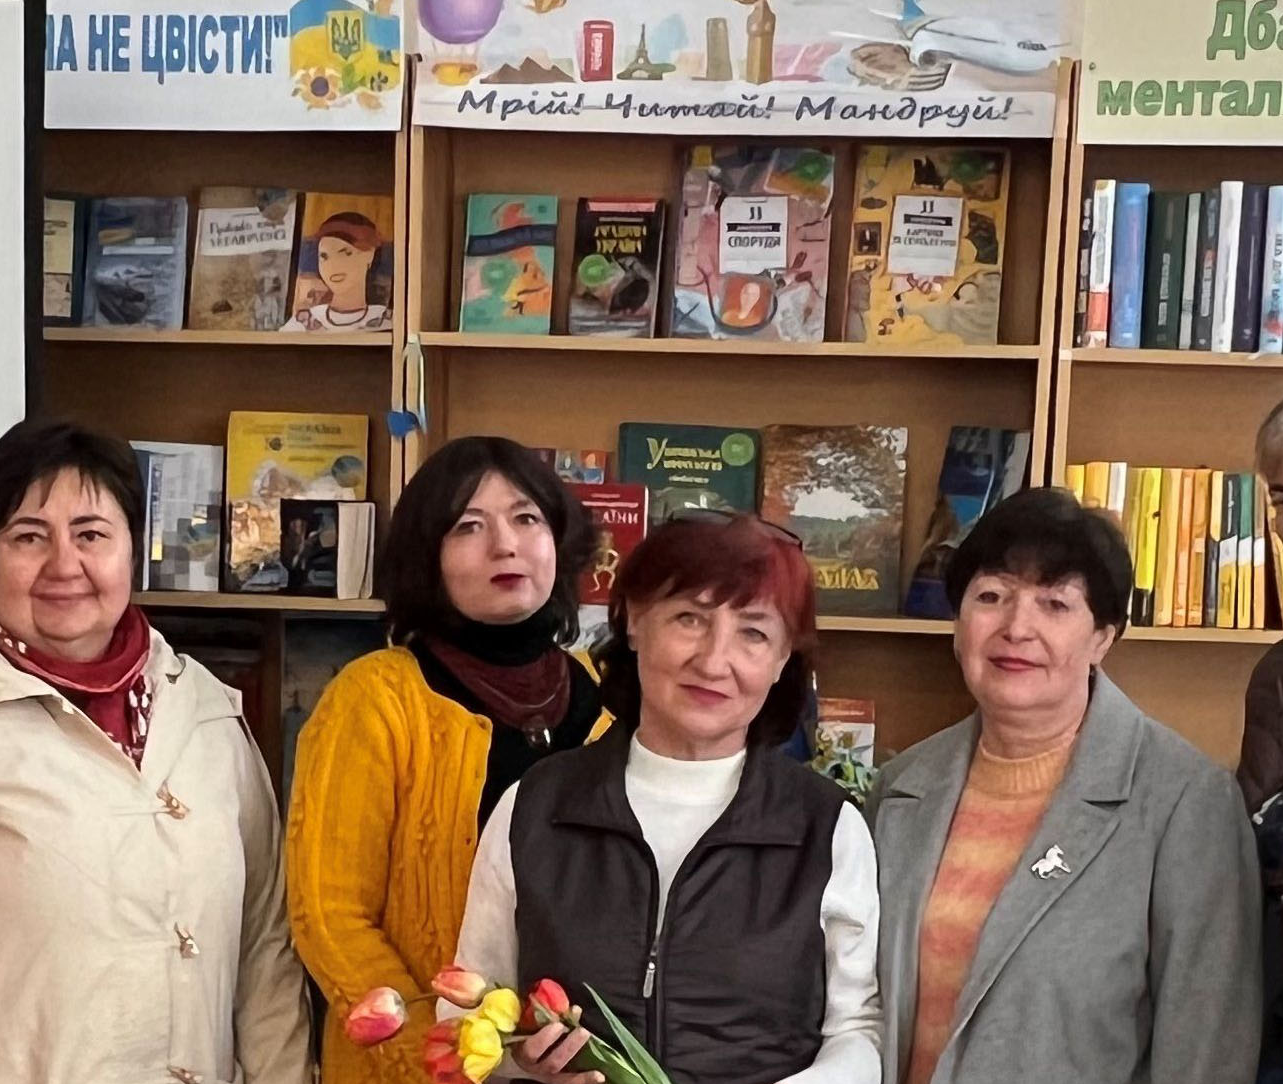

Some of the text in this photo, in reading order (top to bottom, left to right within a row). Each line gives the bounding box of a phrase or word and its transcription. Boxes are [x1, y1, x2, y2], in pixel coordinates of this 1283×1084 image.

[87, 15, 130, 72] НЕ
[457, 89, 1014, 129] Мрій! Читай! Мандруй!
